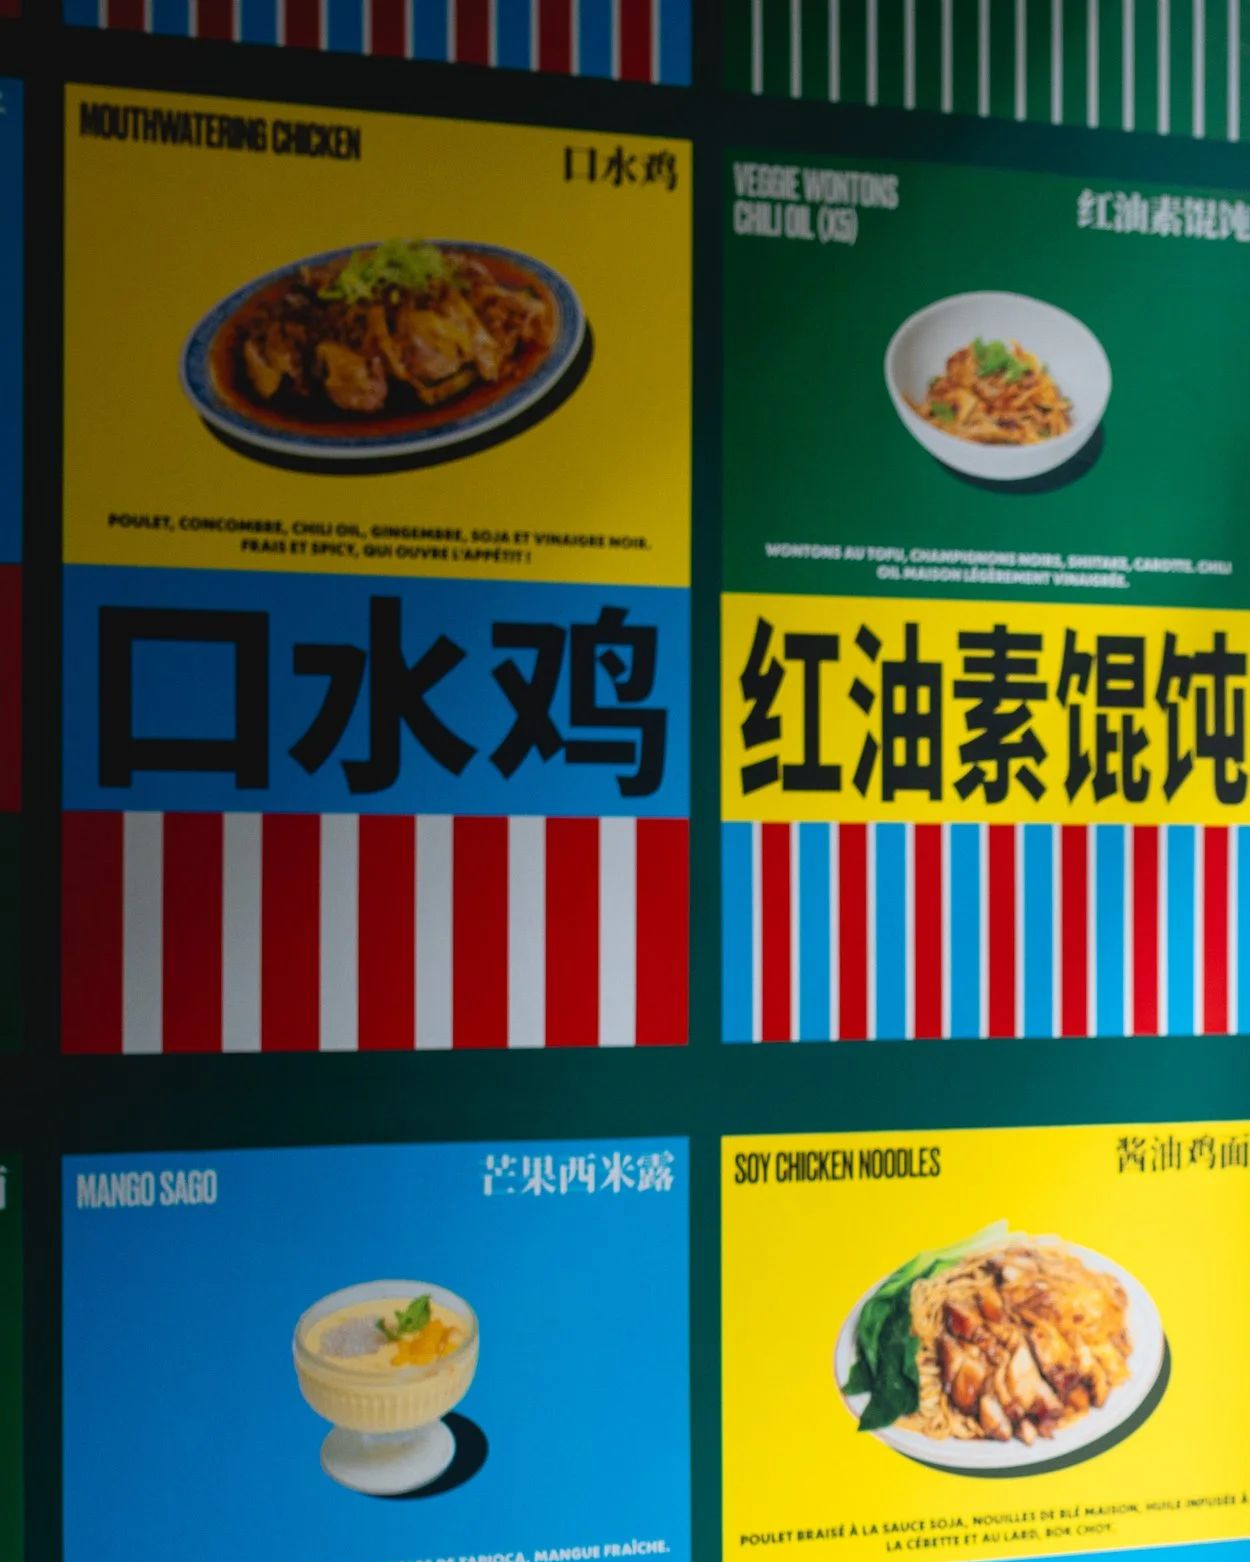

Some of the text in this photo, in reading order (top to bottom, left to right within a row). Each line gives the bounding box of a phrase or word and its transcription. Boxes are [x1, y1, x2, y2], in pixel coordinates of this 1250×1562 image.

[80, 101, 362, 161] MOUTHWATERING CHICKEN
[563, 145, 679, 192] 口水鸡
[733, 162, 899, 210] VEGGIE WONTONS
[733, 200, 783, 237] CHILI
[784, 203, 816, 240] OIL
[108, 513, 174, 531] POULET,
[179, 516, 288, 536] CONCOMBRE,
[292, 520, 332, 536] CHILI
[371, 523, 468, 542] GINGEMBRE,
[471, 527, 509, 543] SOJA
[514, 530, 530, 545] ET
[534, 531, 606, 548] VINAIGRE
[241, 538, 286, 554] FRAIS
[290, 540, 306, 555] ET
[311, 541, 360, 559] SPICY,
[363, 543, 393, 559] QUI
[396, 545, 449, 561] OUVRE
[765, 542, 842, 560] WONTONS
[843, 545, 866, 561] AU
[867, 545, 908, 564] TOFU,
[909, 547, 1016, 566] CHAMPIGNONS
[876, 564, 903, 581] OIL
[904, 566, 962, 583] MAISON
[98, 595, 668, 798] 口水鸡
[740, 614, 1249, 805] 红油素馄饨
[482, 1150, 675, 1197] 芒果西米露
[735, 1147, 941, 1184] SOY CHICKEN NOODLES
[1117, 1133, 1249, 1174] 酱油鸡面
[77, 1169, 218, 1210] MANGO SAGO
[740, 1530, 793, 1547] POULET
[799, 1523, 846, 1542] BRAISÉ
[862, 1521, 878, 1536] LA
[882, 1519, 925, 1535] SAUCE
[929, 1516, 969, 1531] SOJA,
[973, 1511, 1036, 1528] NOUILLES
[1040, 1510, 1054, 1522] DE
[1059, 1504, 1080, 1520] BLÉ
[886, 1539, 903, 1553] LA
[964, 1533, 977, 1546] ET
[982, 1532, 1000, 1544] AU
[1046, 1526, 1071, 1538] BOK
[604, 1539, 671, 1558] FRAÎCHE.
